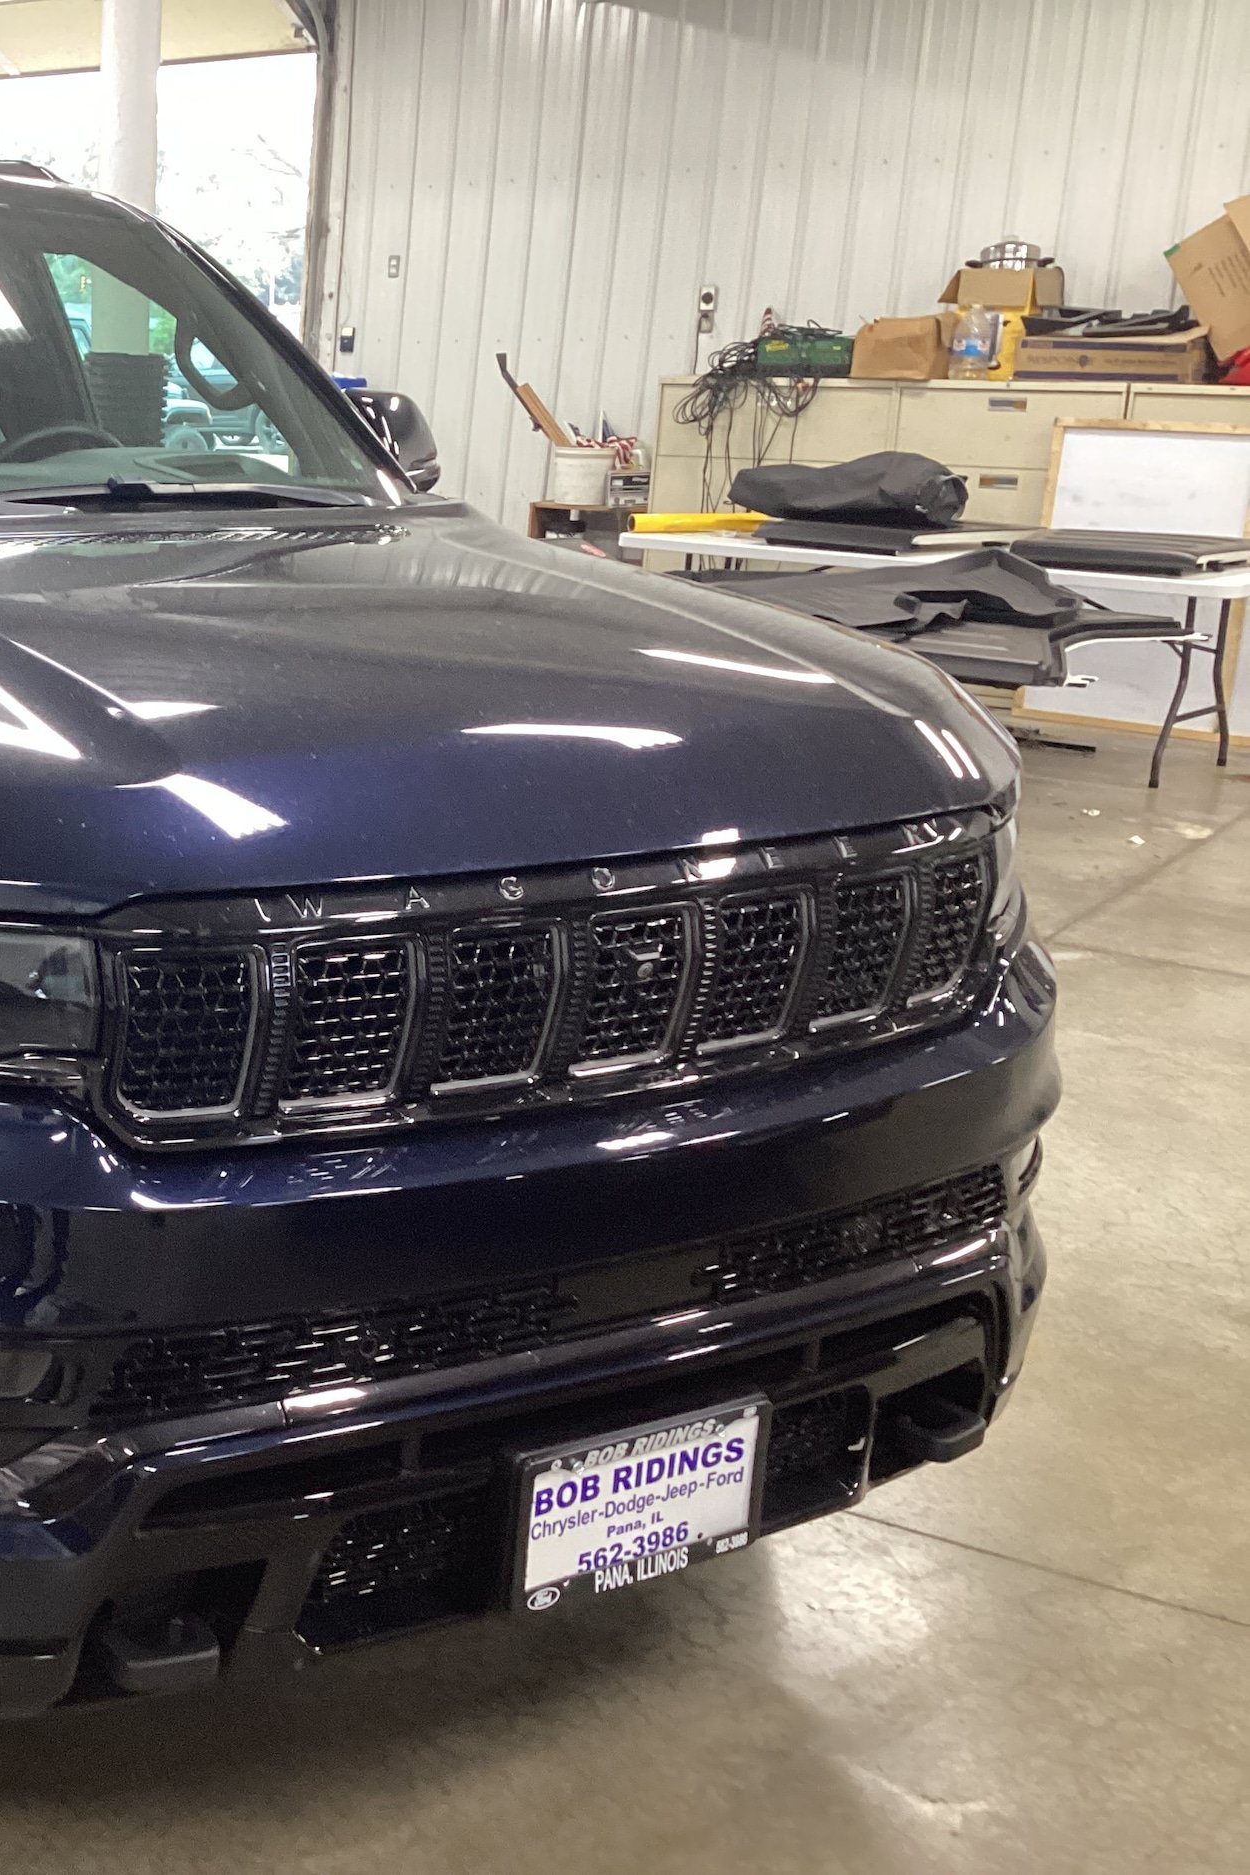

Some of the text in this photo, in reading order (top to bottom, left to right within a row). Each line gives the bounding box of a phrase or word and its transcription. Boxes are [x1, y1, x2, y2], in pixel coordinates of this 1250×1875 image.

[584, 1418, 716, 1469] BOB RIDINGS
[535, 1437, 744, 1518] BOB RIDINGS
[531, 1467, 744, 1540] Chrysler-Dodge-Jeep-Ford
[607, 1511, 664, 1538] Pana, IL
[578, 1521, 689, 1573] 562-3986
[637, 1546, 689, 1581] ILLINOIS
